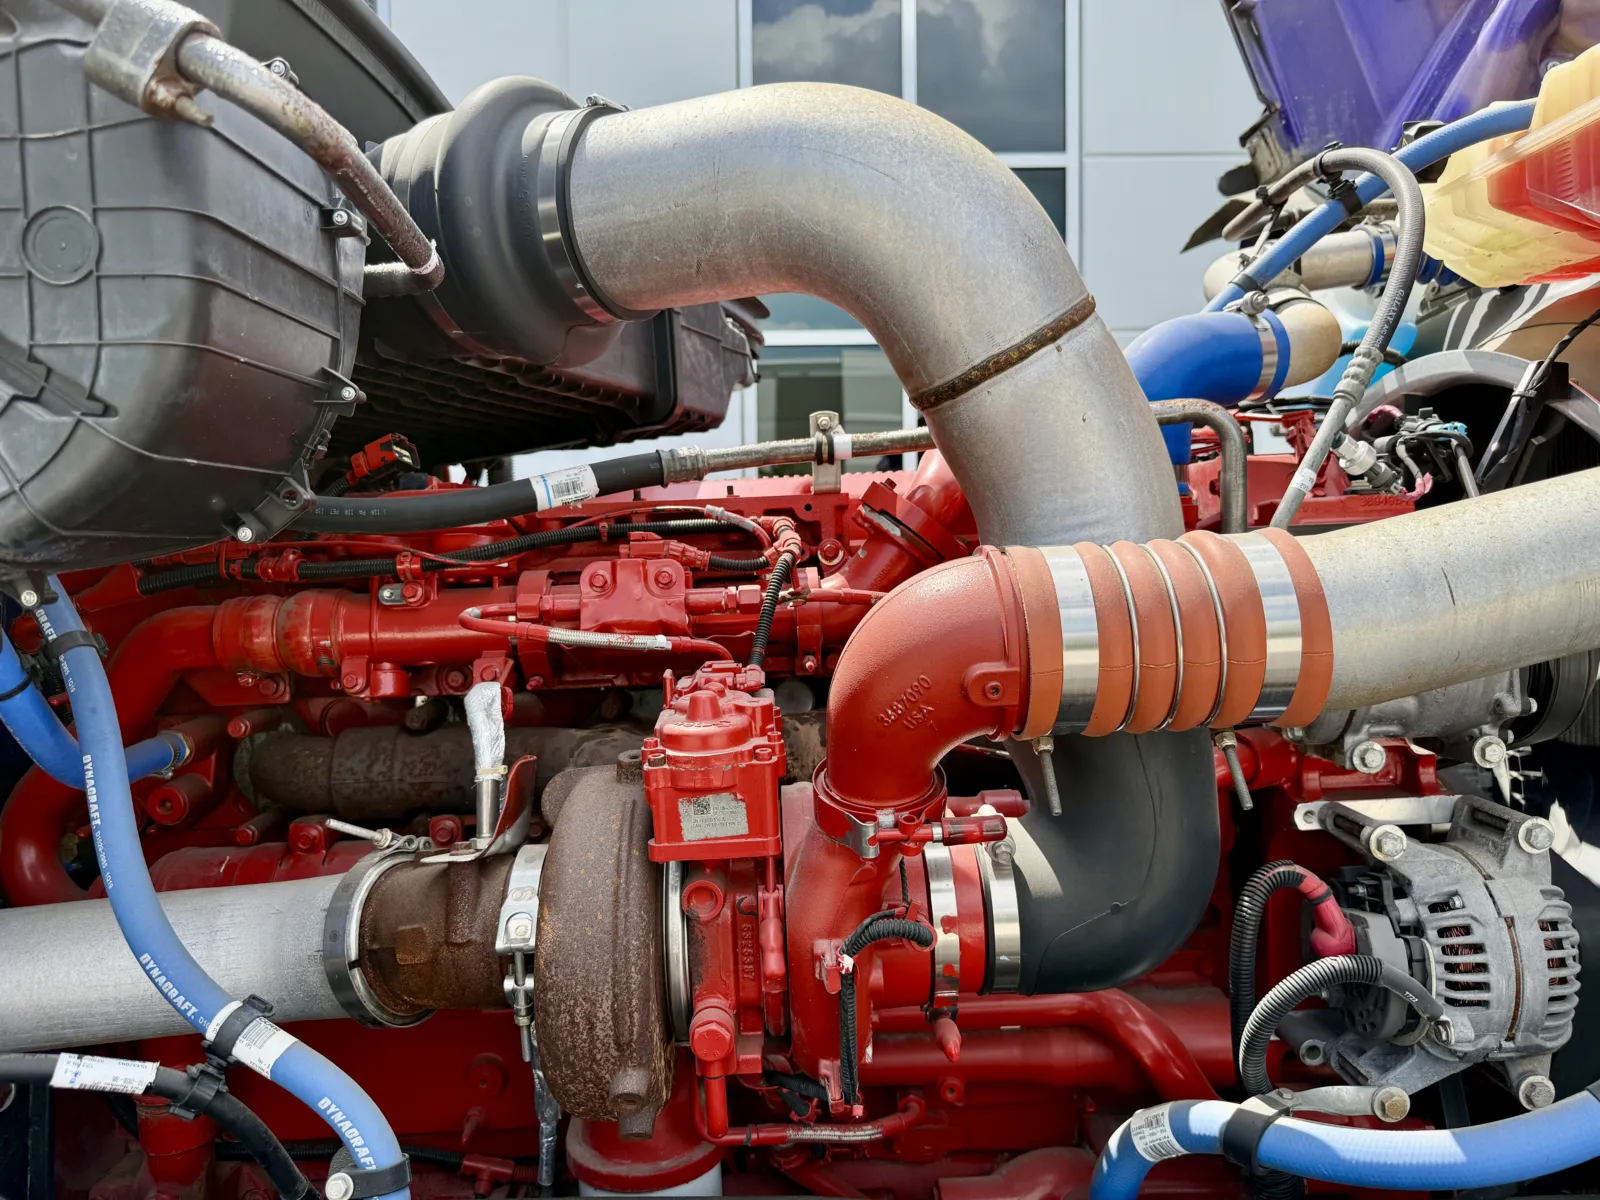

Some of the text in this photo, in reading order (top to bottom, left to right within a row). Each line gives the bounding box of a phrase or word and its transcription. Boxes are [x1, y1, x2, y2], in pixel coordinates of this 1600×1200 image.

[1387, 289, 1405, 323] GALAXY
[35, 608, 57, 642] CRAFT
[876, 673, 934, 727] 3687090
[902, 705, 935, 730] USA
